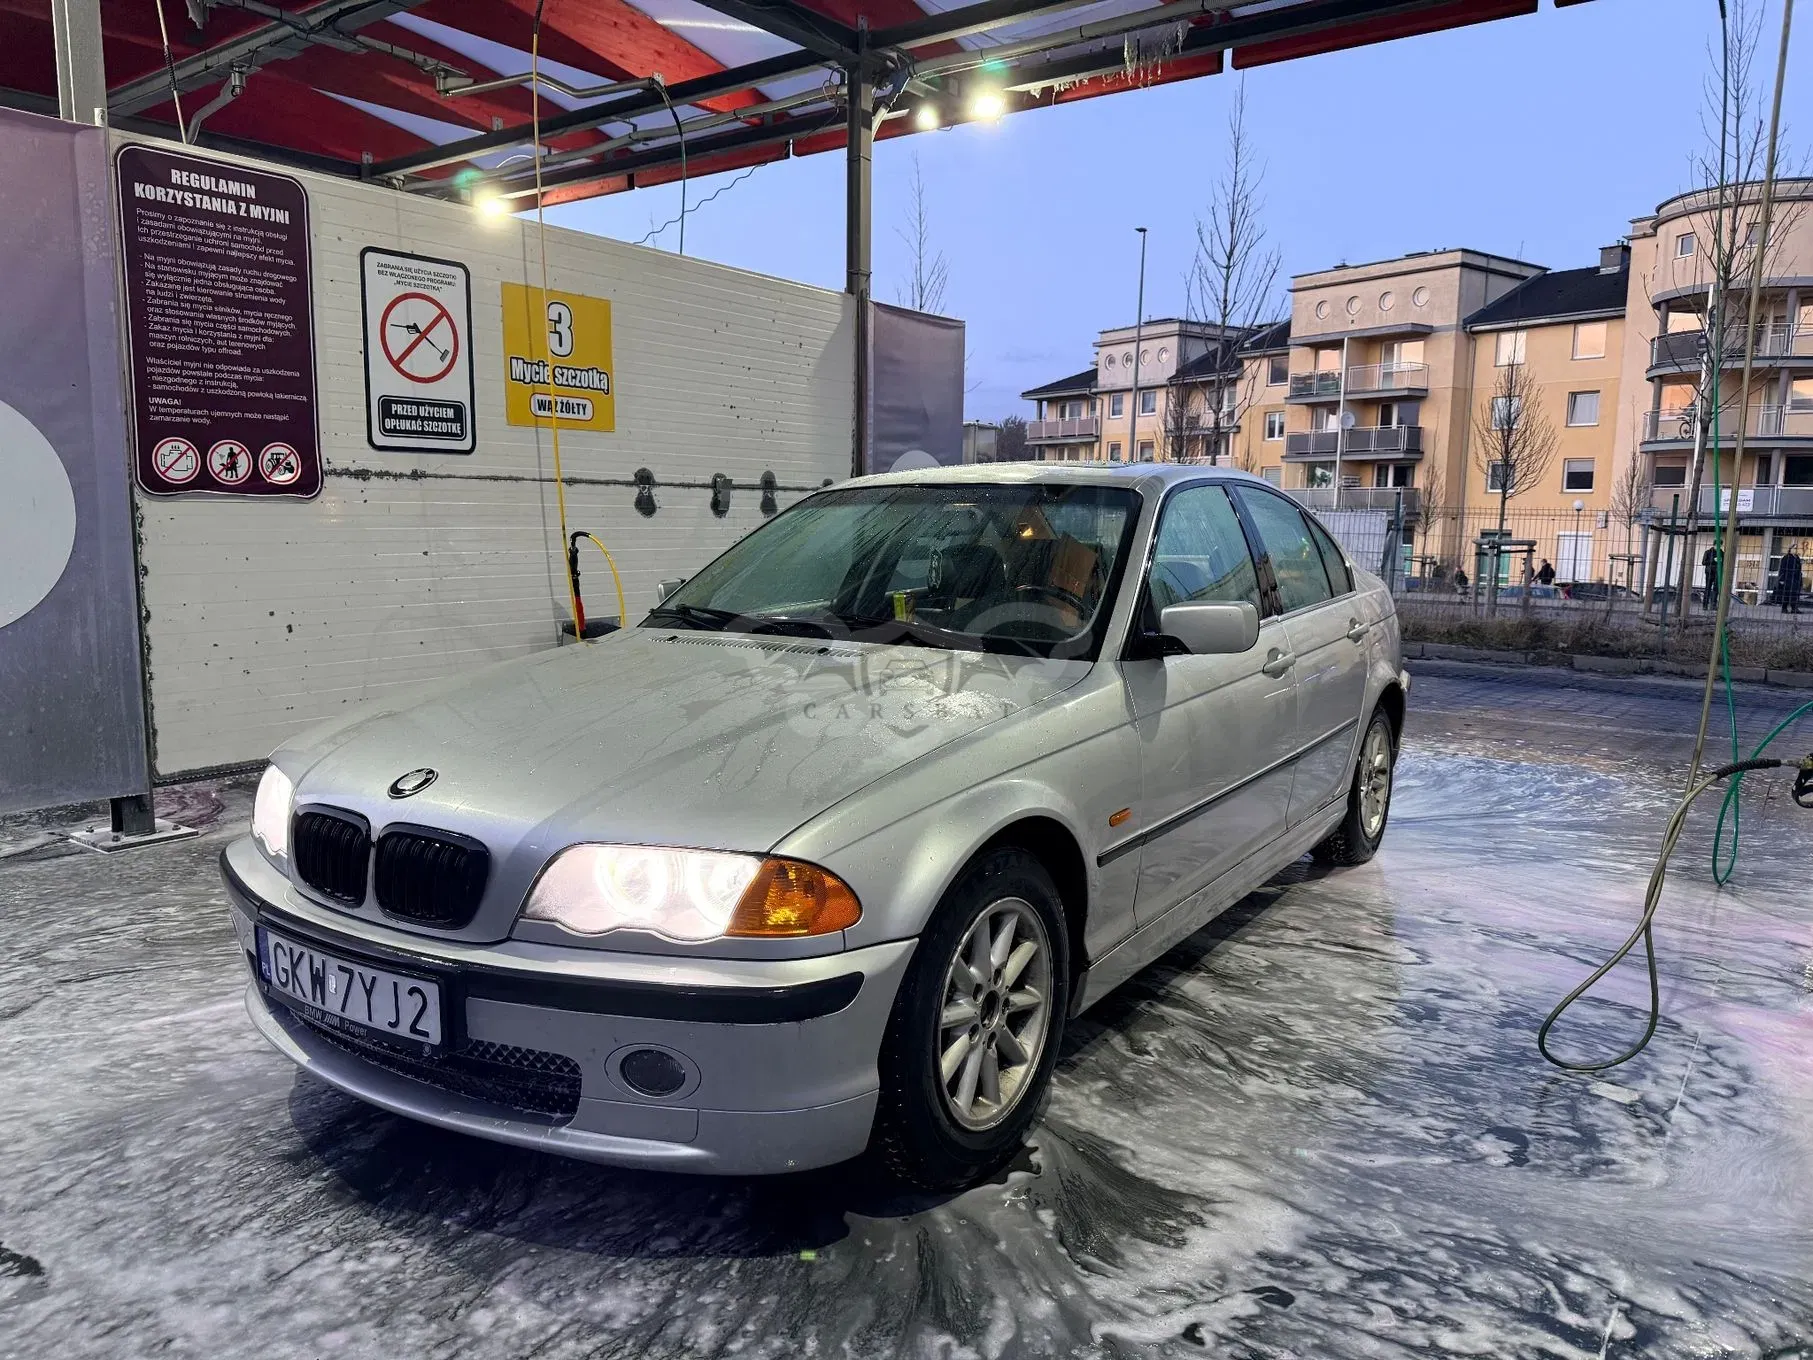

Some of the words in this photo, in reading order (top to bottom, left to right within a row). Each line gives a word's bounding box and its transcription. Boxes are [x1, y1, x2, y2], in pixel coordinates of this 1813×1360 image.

[170, 168, 256, 199] REGULAMIN
[134, 182, 238, 215] KORZYSTANIA
[239, 201, 248, 217] Z
[249, 205, 290, 225] MYJNI
[136, 207, 166, 221] Prosimy
[174, 215, 214, 228] zapoznanie
[141, 218, 176, 230] zasadami
[177, 224, 232, 239] obowiązującymi
[233, 233, 242, 241] na
[137, 225, 149, 234] Ich
[150, 227, 203, 243] przestrzeganie
[204, 236, 230, 247] uchroni
[231, 241, 265, 253] samochód
[266, 246, 284, 256] przed
[138, 236, 192, 249] uszkodzeniami
[197, 244, 225, 255] zapewni
[144, 252, 155, 261] Na
[156, 255, 176, 265] myjni
[177, 258, 217, 271] obowiązują
[218, 264, 242, 274] zasady
[243, 268, 262, 277] ruchu
[263, 271, 298, 283] drogowego
[144, 261, 156, 270] Na
[157, 264, 197, 276] stanowisku
[229, 274, 249, 283] może
[376, 262, 404, 271] ZABRANIA
[377, 269, 389, 277] BEZ
[144, 270, 156, 280] się
[193, 276, 213, 286] jedna
[145, 278, 181, 291] Zakazane
[183, 284, 196, 292] jest
[197, 285, 234, 298] kierowanie
[234, 291, 269, 302] strumienia
[269, 297, 286, 306] wody
[145, 288, 156, 296] na
[157, 288, 174, 298] ludzi
[146, 295, 179, 307] Zabrania
[180, 301, 191, 310] się
[192, 303, 213, 312] mycia
[243, 309, 263, 318] mycia
[147, 306, 163, 314] oraz
[165, 307, 205, 319] stosowania
[148, 313, 181, 324] Zabrania
[193, 319, 214, 328] mycia
[547, 301, 574, 358] 3
[148, 322, 171, 331] Zakaz
[172, 326, 194, 335] mycia
[198, 328, 237, 339] korzystania
[243, 333, 261, 343] myjni
[148, 332, 177, 342] maszyn
[228, 340, 266, 351] terenowych
[148, 340, 166, 348] oraz
[166, 342, 201, 352] pojazdów
[201, 345, 217, 354] typu
[146, 366, 181, 375] pojazdów
[214, 371, 243, 380] podczas
[183, 360, 202, 369] myjni
[215, 363, 252, 373] odpowiada
[261, 368, 300, 378] uszkodzenia
[510, 356, 551, 385] Mycie
[551, 365, 610, 396] szczotką
[151, 374, 198, 386] niezgodnego
[152, 383, 199, 393] samochodów
[148, 396, 182, 406] UWAGA!
[559, 398, 587, 416] ŻÓŁTY
[148, 405, 158, 413] W
[158, 406, 209, 416] temperaturach
[210, 409, 243, 419] ujemnych
[243, 411, 262, 420] może
[149, 415, 191, 423] zamarzanie
[391, 403, 418, 416] PRZED
[419, 404, 455, 419] UŻYCIEM
[384, 418, 422, 431] OPŁUKAĆ
[423, 420, 462, 436] SZCZOTKĘ
[261, 962, 271, 978] PL
[273, 941, 326, 1006] GKW
[337, 964, 430, 1039] 7YJ2
[304, 1005, 323, 1021] BMW
[344, 1020, 368, 1037] Power
